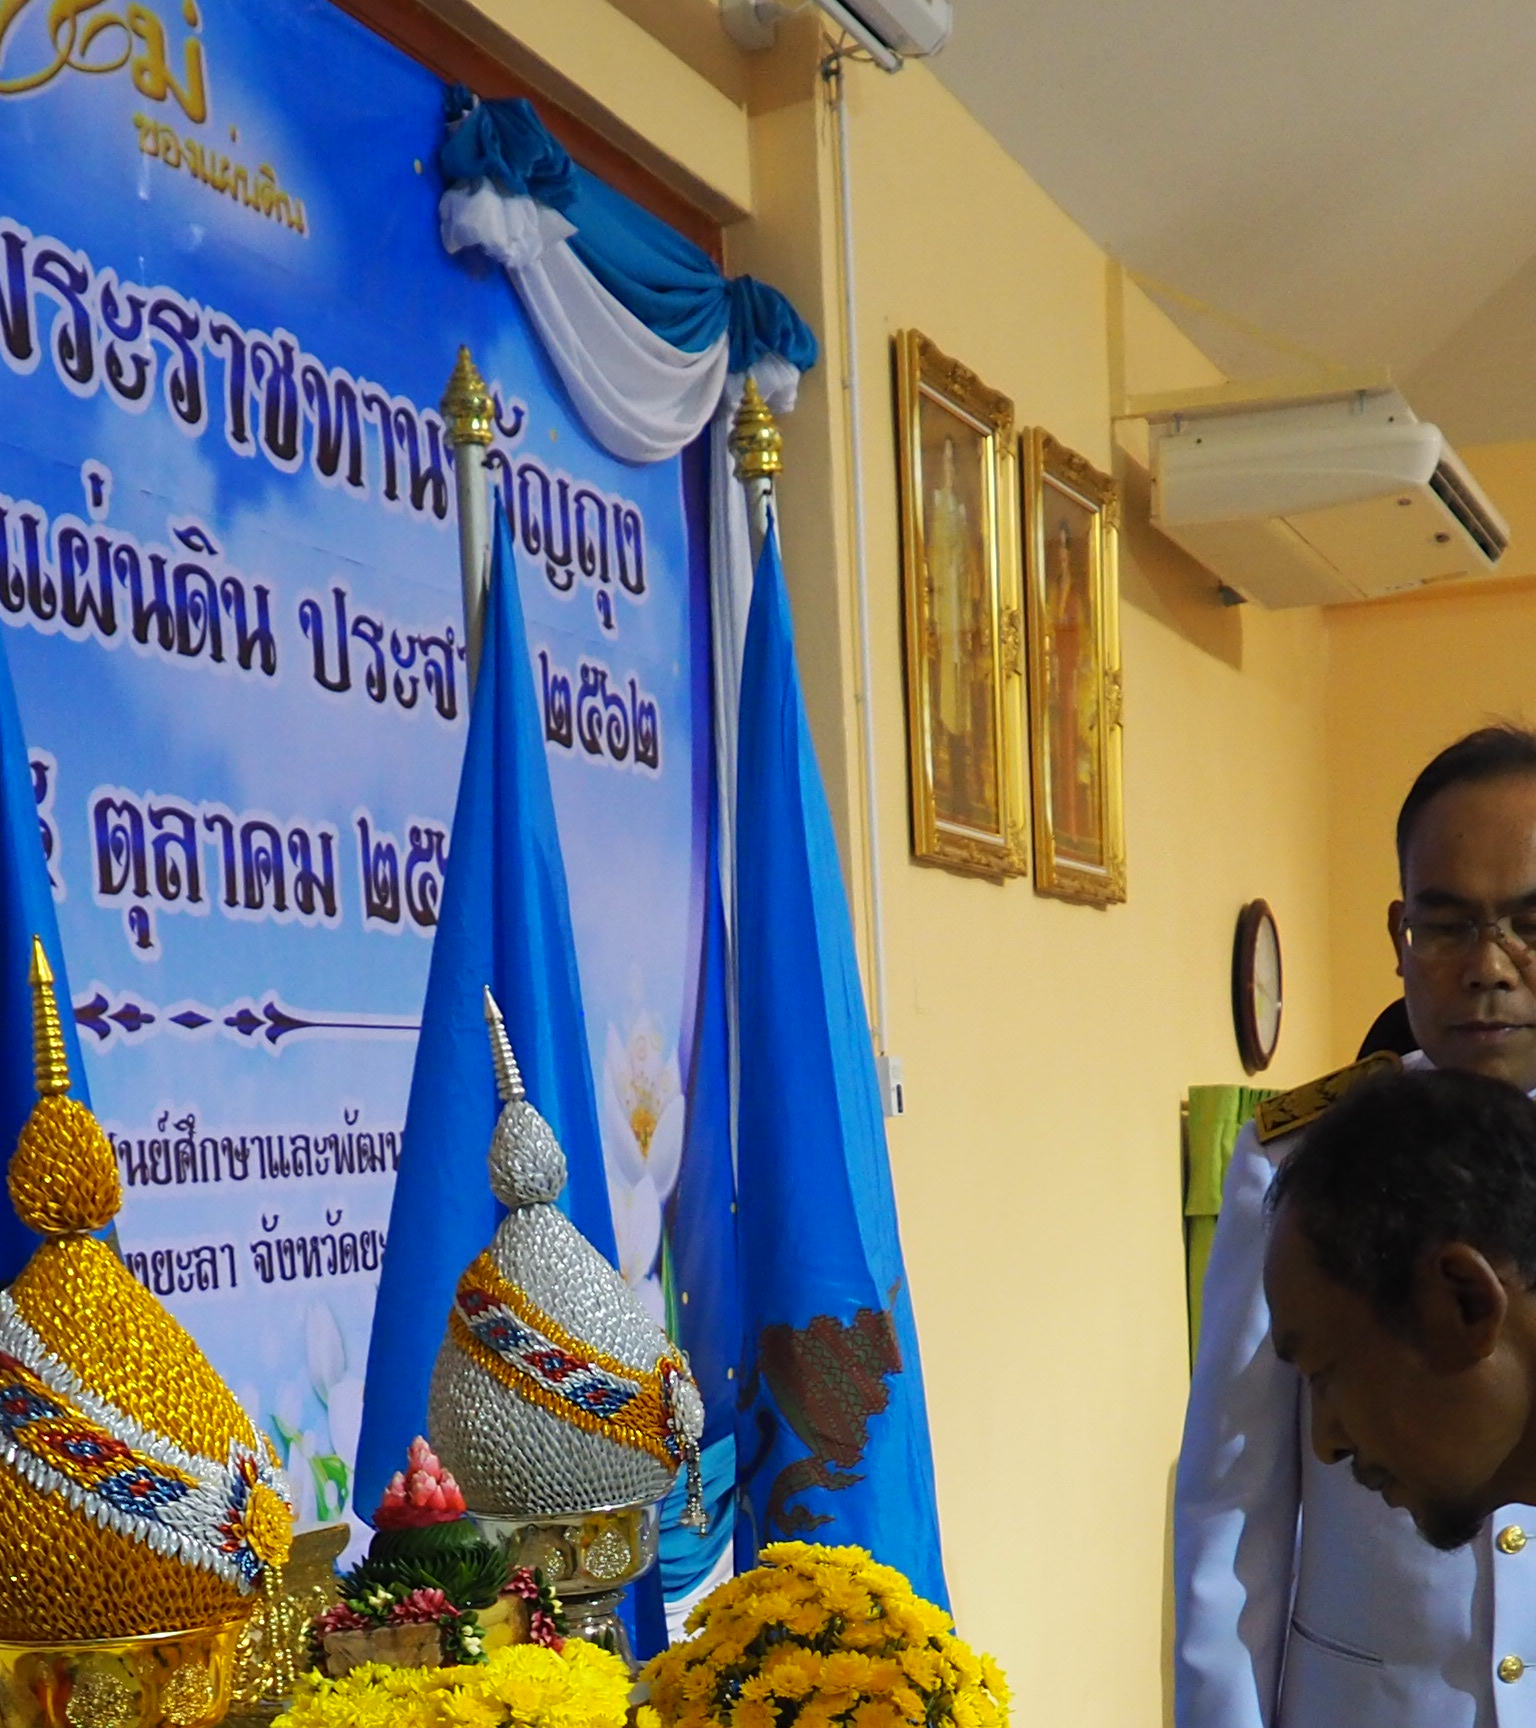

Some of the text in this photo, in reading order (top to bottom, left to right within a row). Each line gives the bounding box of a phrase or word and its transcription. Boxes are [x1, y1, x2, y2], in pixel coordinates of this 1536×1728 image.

[538, 650, 660, 769] ๒๕๖๒
[94, 797, 337, 949] ตุลาคม
[357, 816, 448, 927] ๒๕
